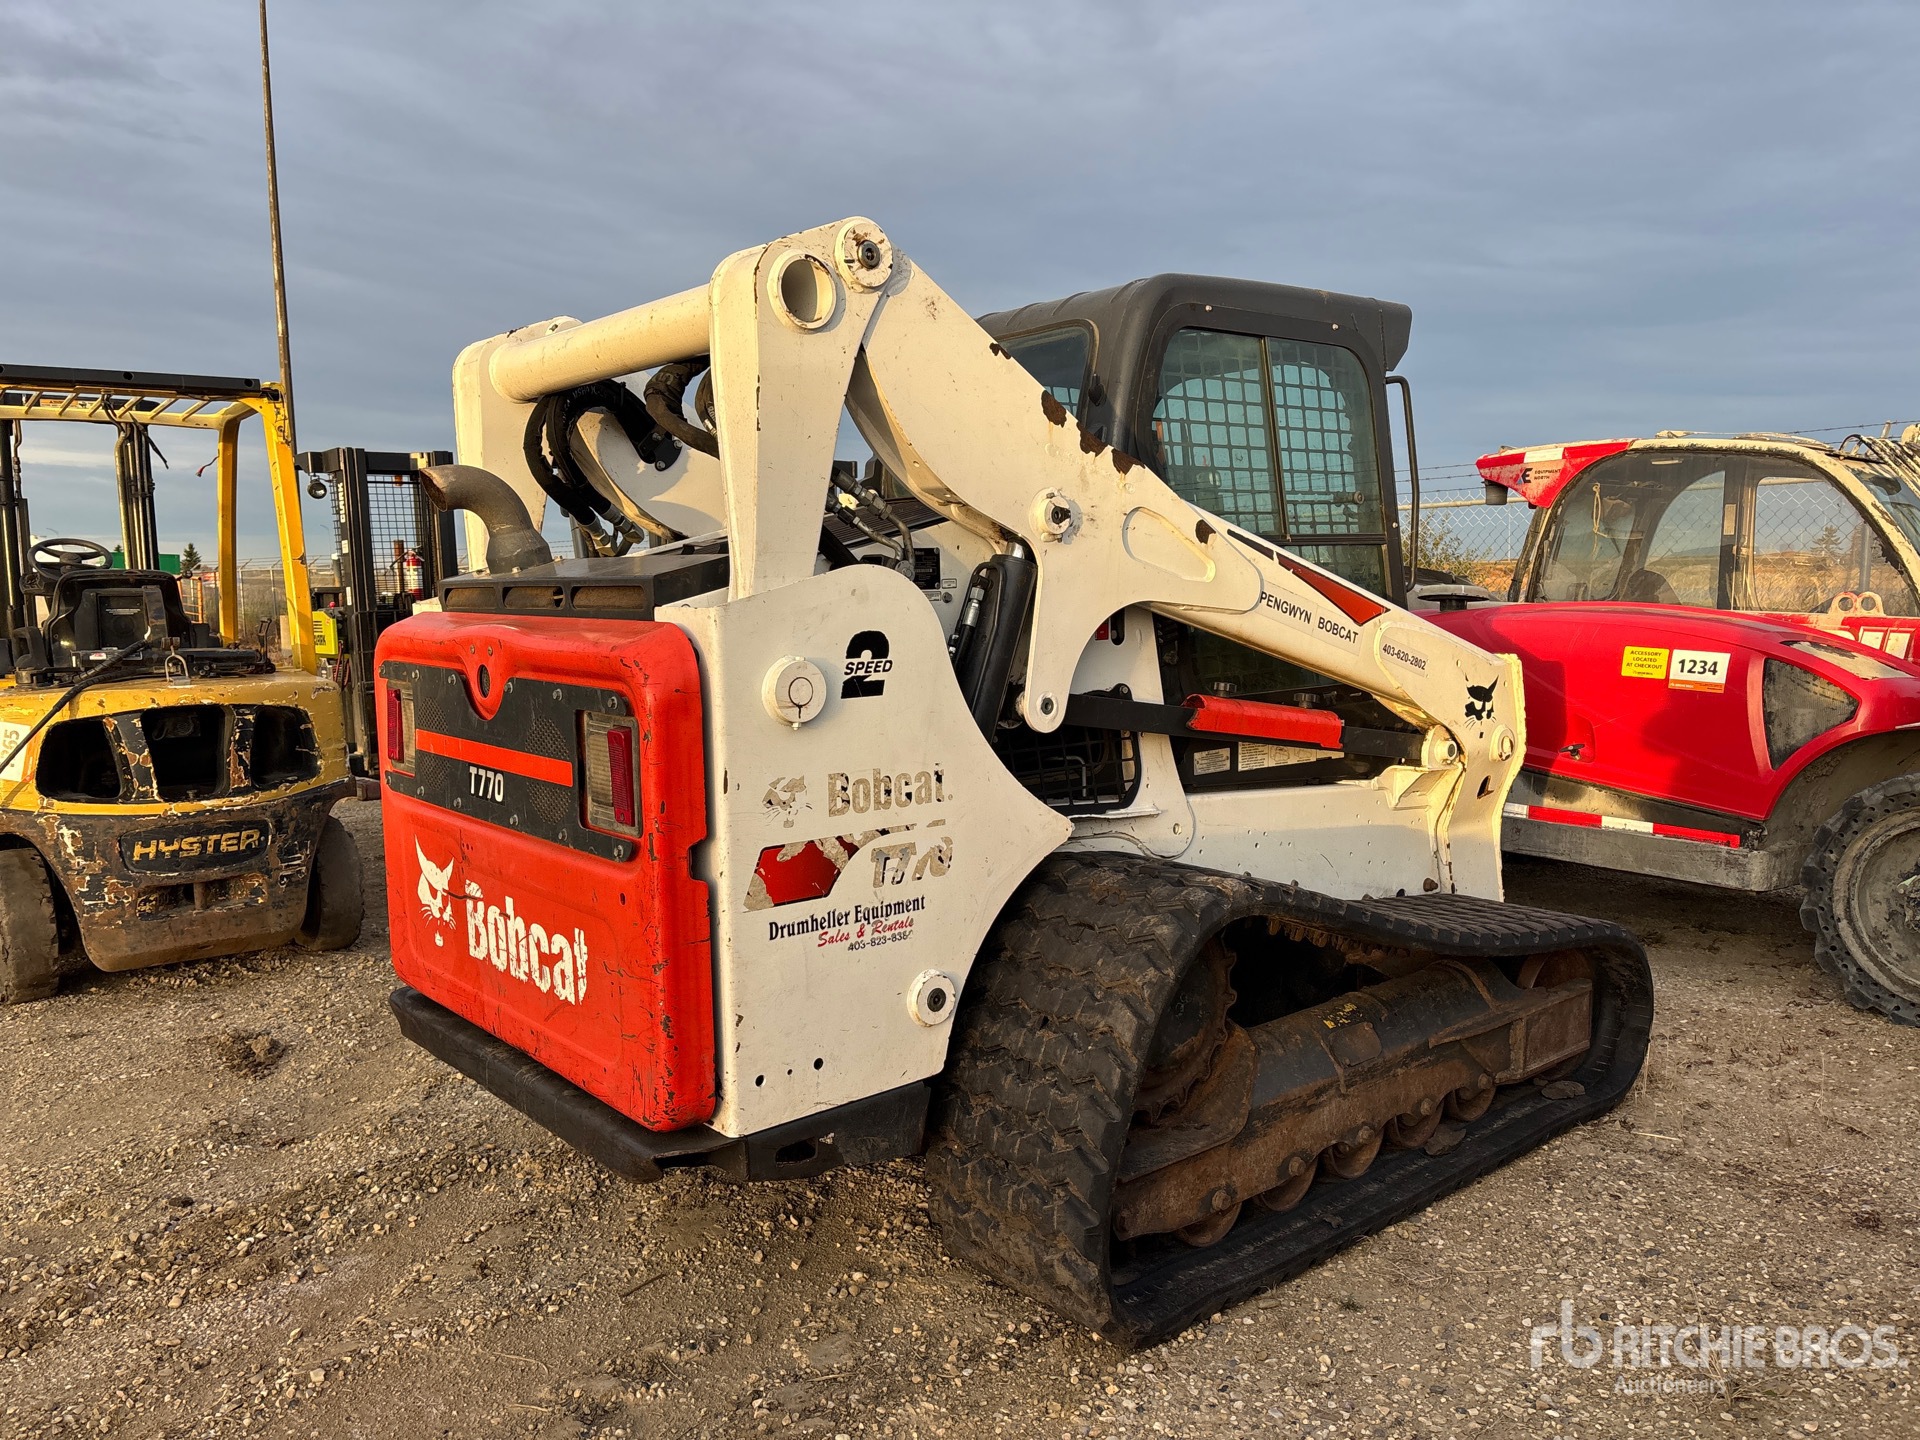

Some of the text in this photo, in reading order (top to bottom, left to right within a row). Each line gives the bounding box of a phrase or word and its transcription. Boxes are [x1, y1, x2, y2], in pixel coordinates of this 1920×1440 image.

[337, 482, 346, 523] CLARK
[1259, 591, 1359, 644] PENGWYN BOBCAT
[841, 630, 889, 699] 2
[844, 660, 893, 675] SPEED
[1382, 643, 1427, 671] 403-620-2802
[1678, 659, 1718, 676] 1234
[469, 766, 504, 802] T770
[828, 763, 944, 817] Bobcat
[133, 829, 260, 862] HYSTER
[769, 895, 925, 941] Drumheller Equipment
[817, 929, 850, 948] Sales
[857, 924, 865, 938] &
[465, 879, 588, 1005] Bobcat
